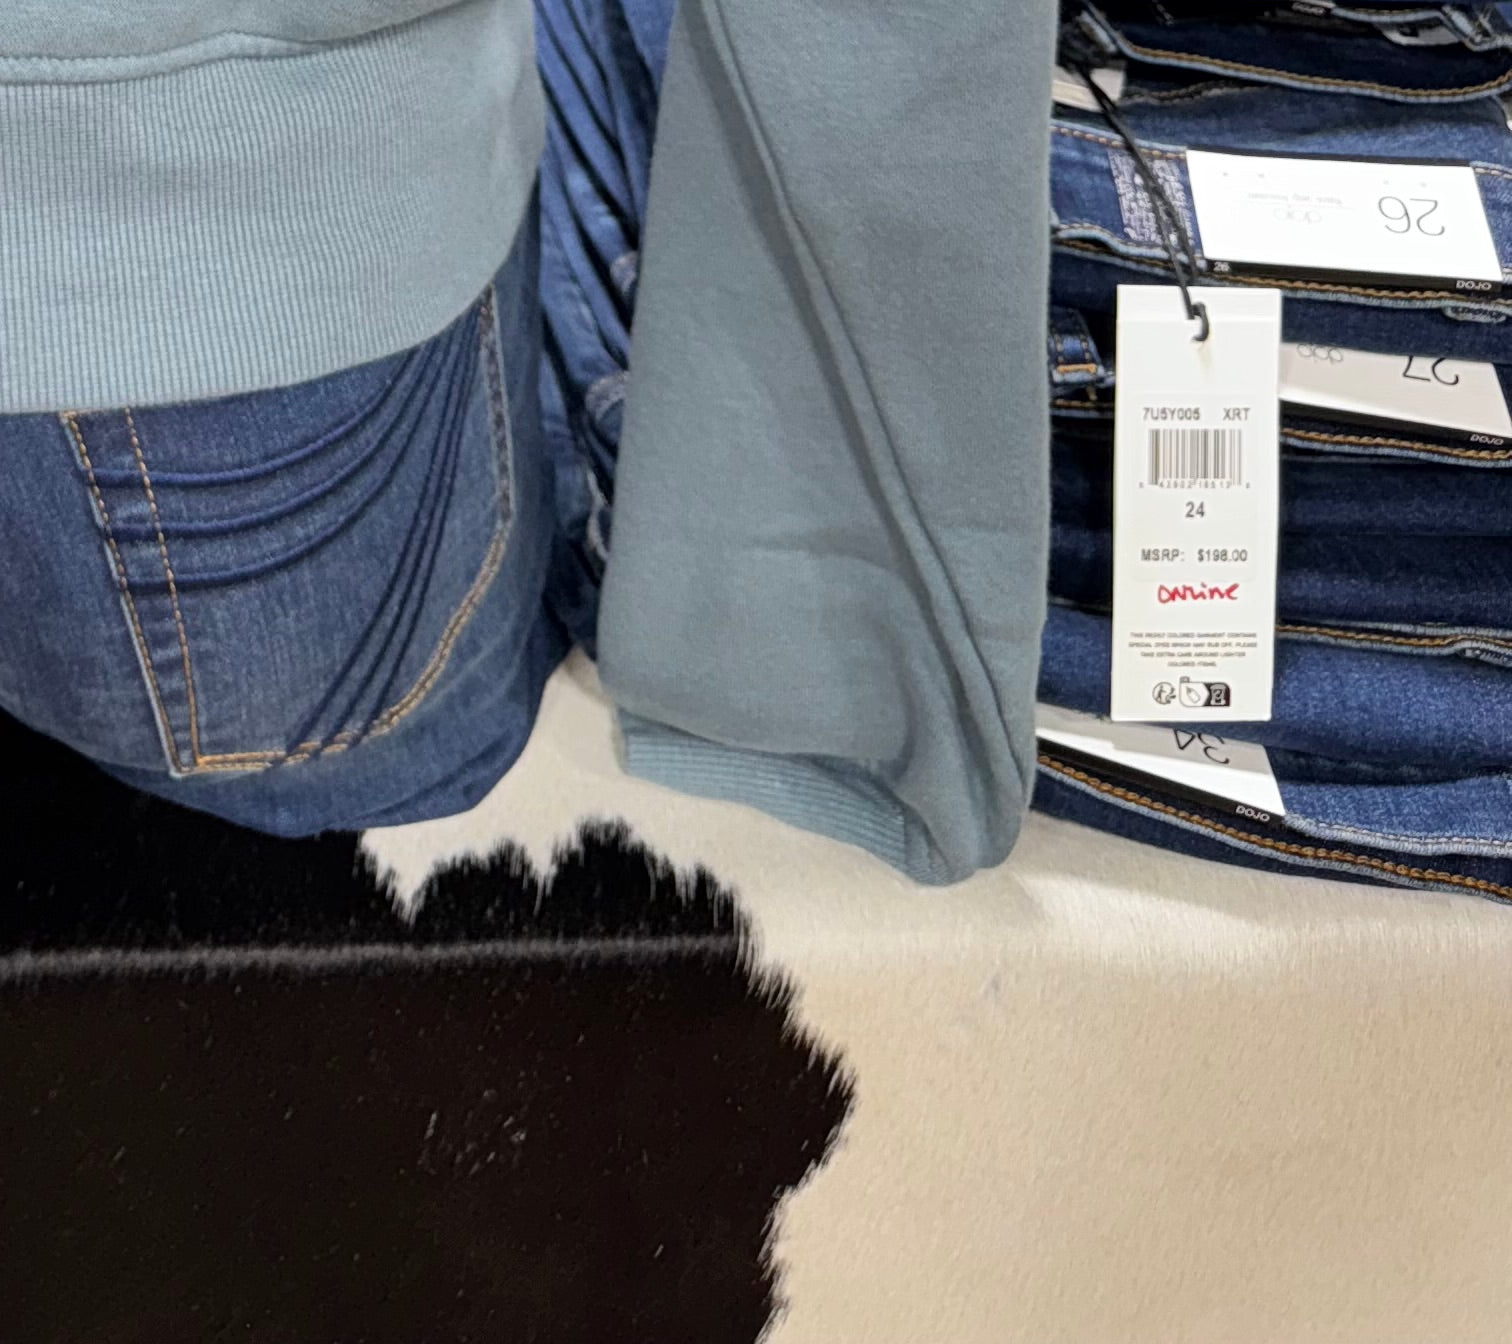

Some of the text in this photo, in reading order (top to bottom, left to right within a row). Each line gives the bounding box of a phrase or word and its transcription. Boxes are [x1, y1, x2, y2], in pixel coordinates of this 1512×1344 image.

[1377, 195, 1446, 237] 26
[1455, 279, 1493, 291] DOJO
[1402, 355, 1459, 386] 27
[1222, 407, 1251, 421] XRT
[1469, 433, 1505, 446] DOJO
[1184, 500, 1206, 519] 24
[1140, 548, 1248, 563] MSRP: $198.00
[1172, 728, 1230, 764] 34
[1235, 805, 1271, 823] DOJO
